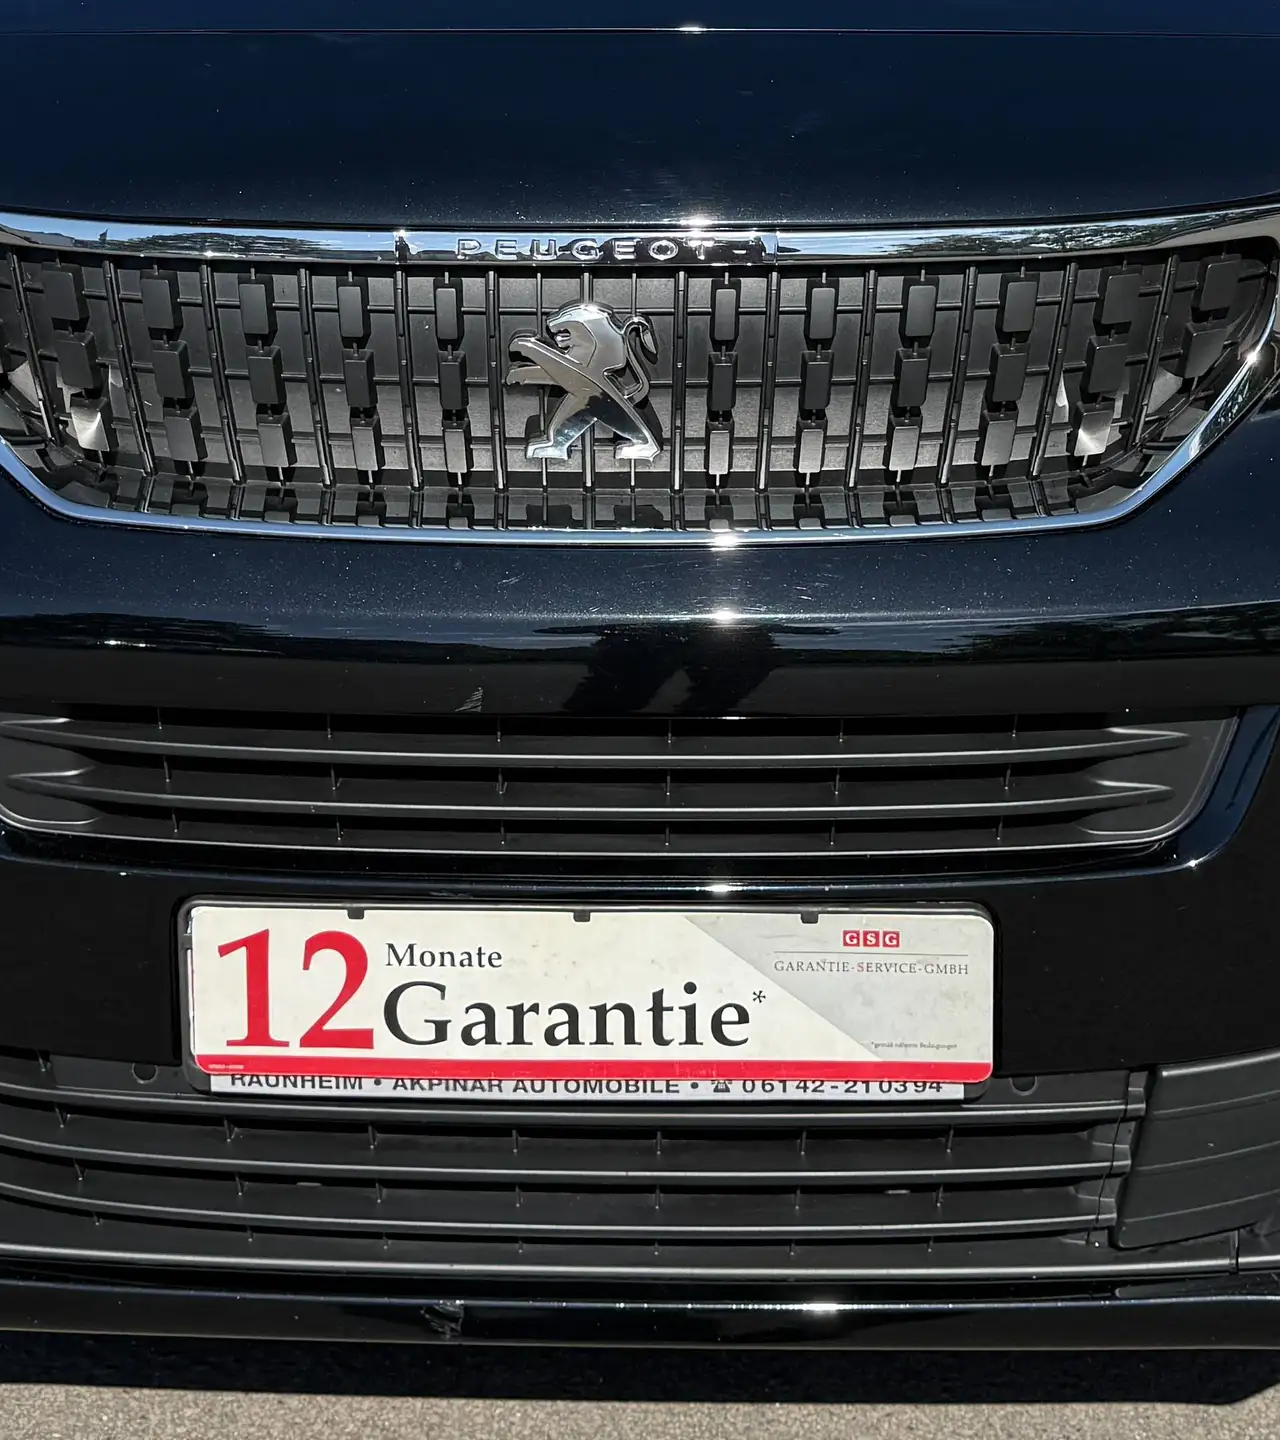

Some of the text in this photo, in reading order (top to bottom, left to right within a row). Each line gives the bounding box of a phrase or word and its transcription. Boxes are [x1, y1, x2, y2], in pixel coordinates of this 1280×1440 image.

[457, 238, 713, 261] PEUGEOT
[843, 931, 900, 947] GSG
[385, 942, 503, 969] Monate
[774, 960, 969, 976] GARANTIE-SERVICE-GMBH
[217, 929, 375, 1049] 12
[230, 1075, 363, 1091] RAUNHEIM
[392, 1077, 503, 1093] AKPINAR
[512, 1078, 680, 1094] AUTOMOBILE
